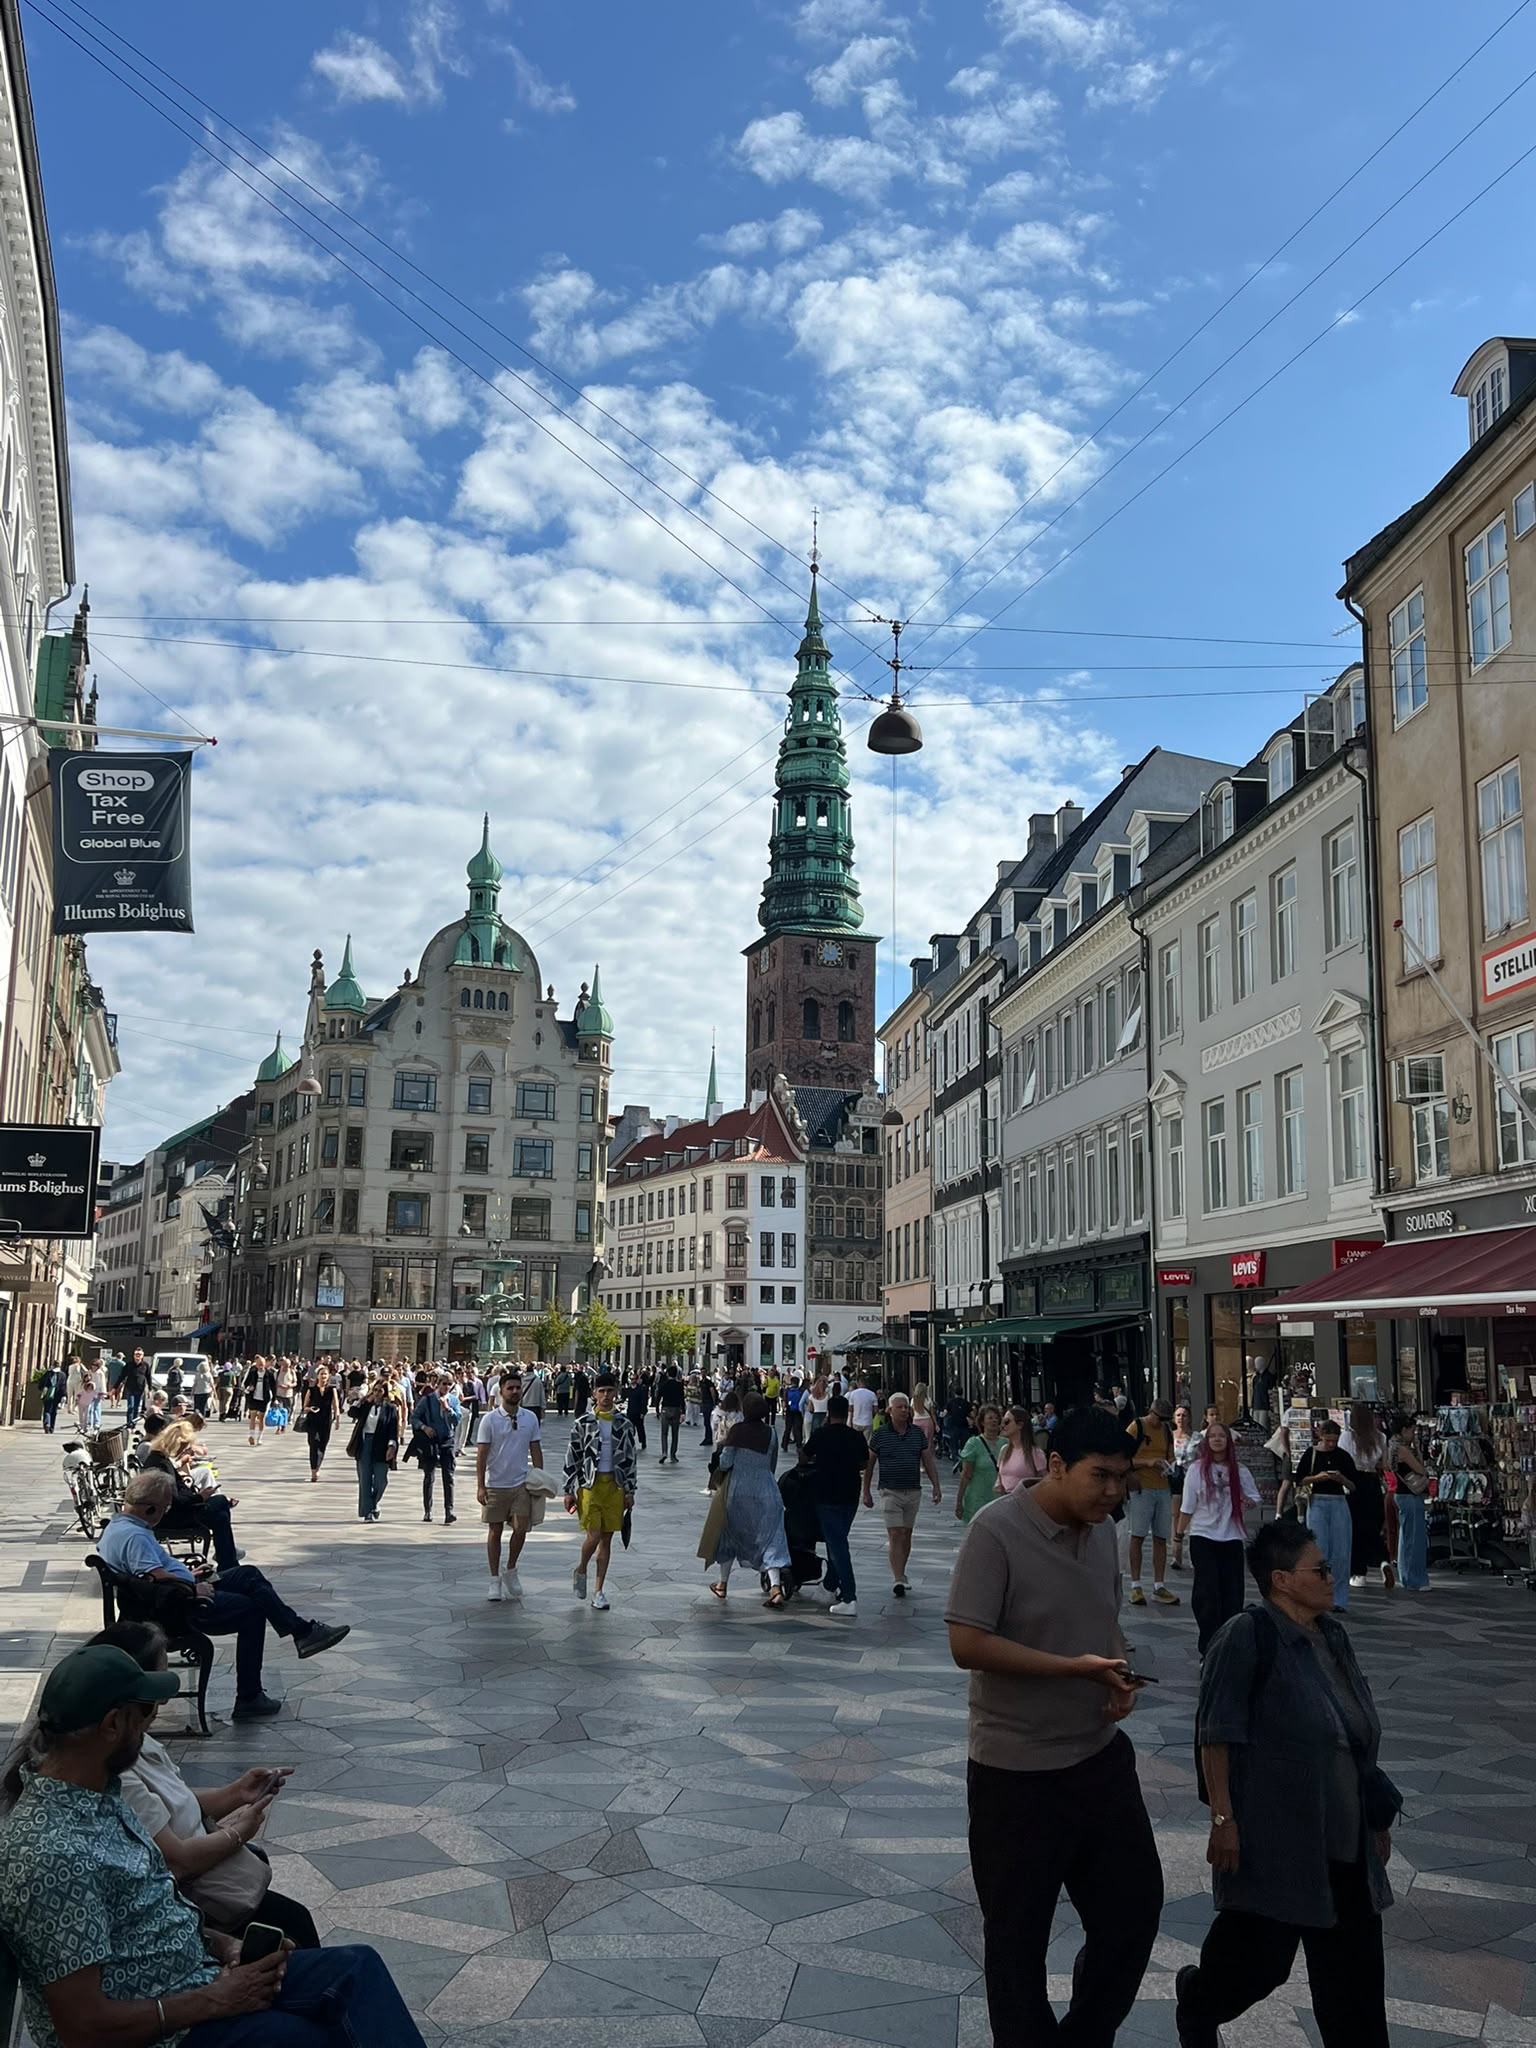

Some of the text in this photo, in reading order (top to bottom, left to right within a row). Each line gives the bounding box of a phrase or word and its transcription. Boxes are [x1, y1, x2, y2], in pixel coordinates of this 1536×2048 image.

[86, 773, 146, 790] Shop
[86, 793, 128, 808] Tax
[92, 811, 145, 825] Free
[80, 838, 161, 849] Global Blue
[64, 903, 186, 922] Illums Bolighus
[1494, 948, 1536, 983] STELLI
[28, 1180, 85, 1196] Bolighus
[1406, 1210, 1453, 1232] SOUVENIRS
[1506, 1304, 1527, 1314] Tax free
[372, 1313, 433, 1322] LOUIS VUITTON
